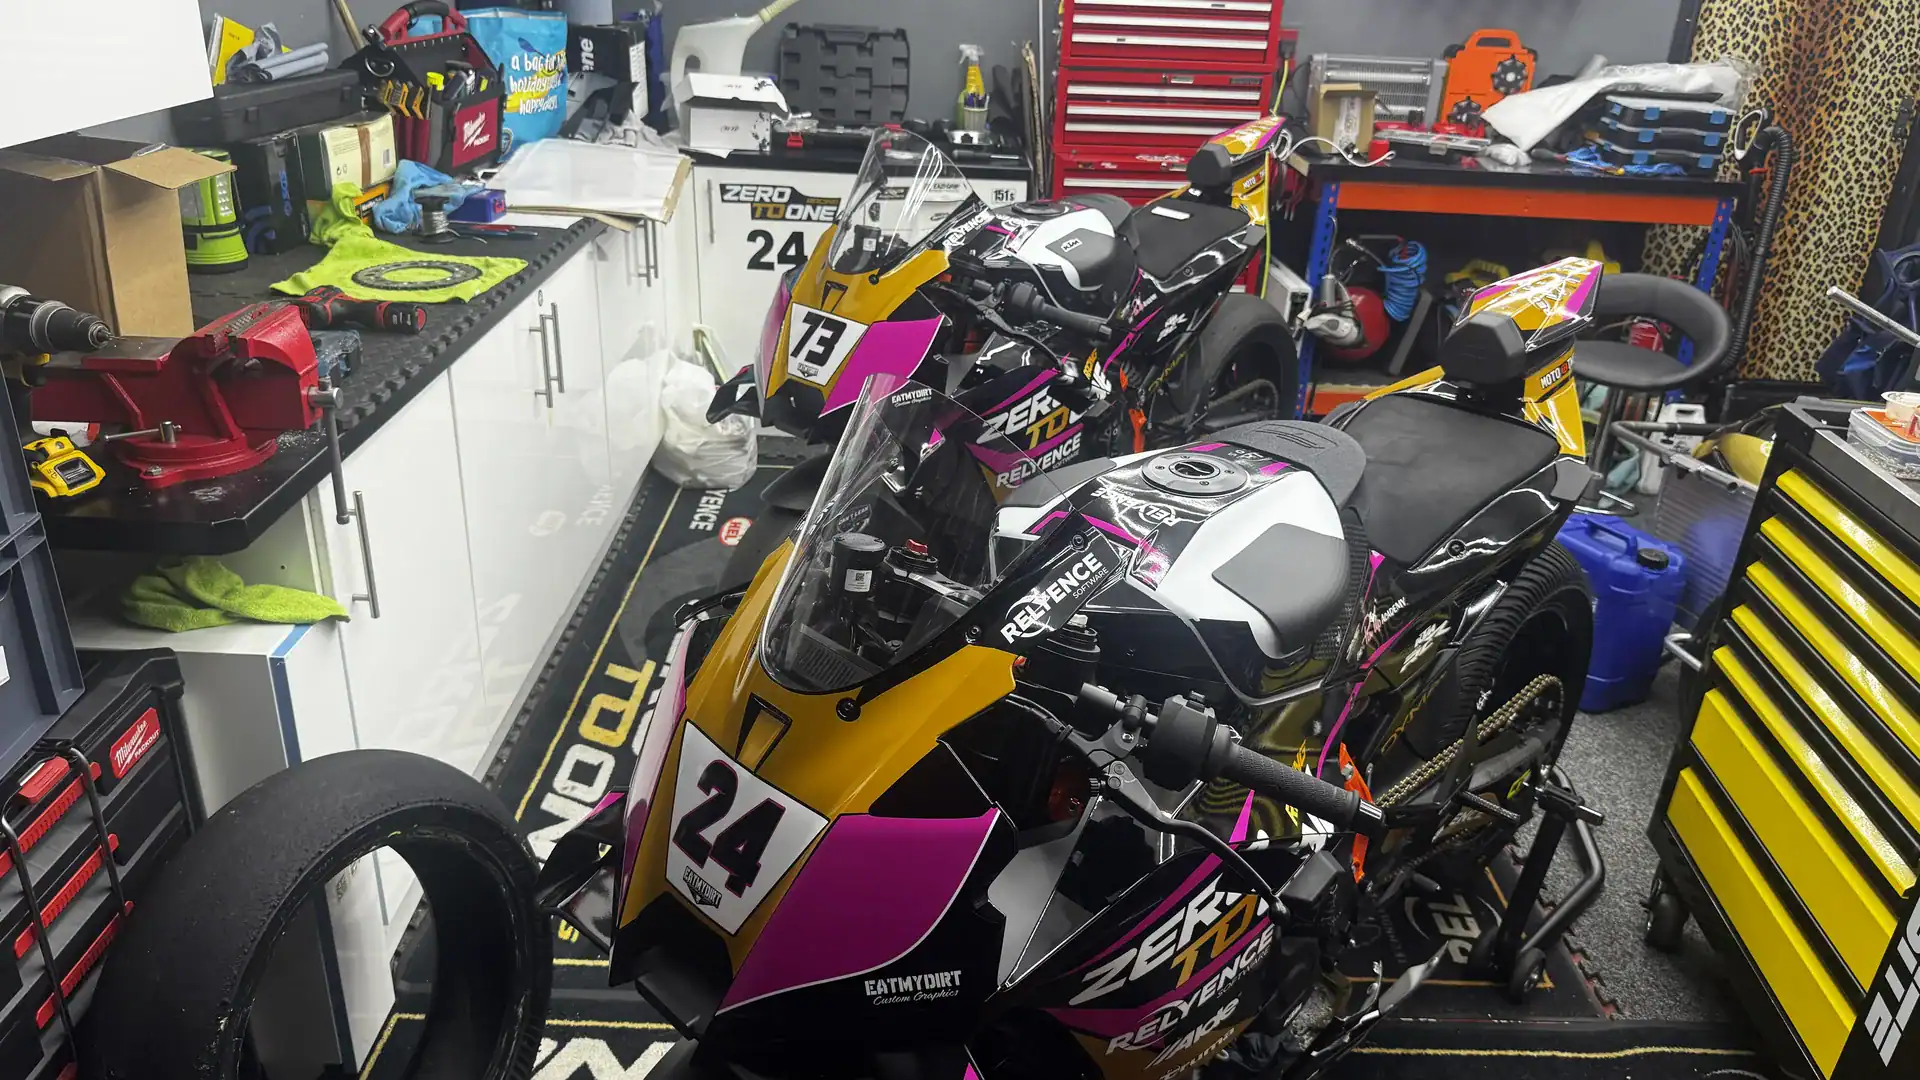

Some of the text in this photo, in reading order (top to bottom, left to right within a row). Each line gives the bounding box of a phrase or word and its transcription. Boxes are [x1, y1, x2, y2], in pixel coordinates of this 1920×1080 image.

[511, 55, 520, 71] a
[722, 184, 793, 203] ZERO
[752, 203, 838, 221] TO ONE
[746, 229, 809, 271] 24
[789, 310, 848, 368] 73
[891, 387, 932, 404] EATMYDIRT
[1540, 366, 1562, 389] MOTO
[995, 432, 1083, 490] RELYENCE
[724, 521, 741, 541] HEL
[1000, 552, 1103, 644] RELYENCE
[1072, 566, 1109, 599] SOFTWARE
[114, 720, 148, 769] Milwaukee
[134, 729, 159, 759] PACKOUT
[526, 743, 616, 870] ON
[672, 759, 786, 899] 24
[682, 866, 723, 909] EATMYDIRT
[1170, 894, 1258, 989] TO
[864, 969, 962, 997] EATMYDIRT
[872, 988, 960, 1006] Custom Graphics
[1104, 923, 1275, 1057] RELYENCE
